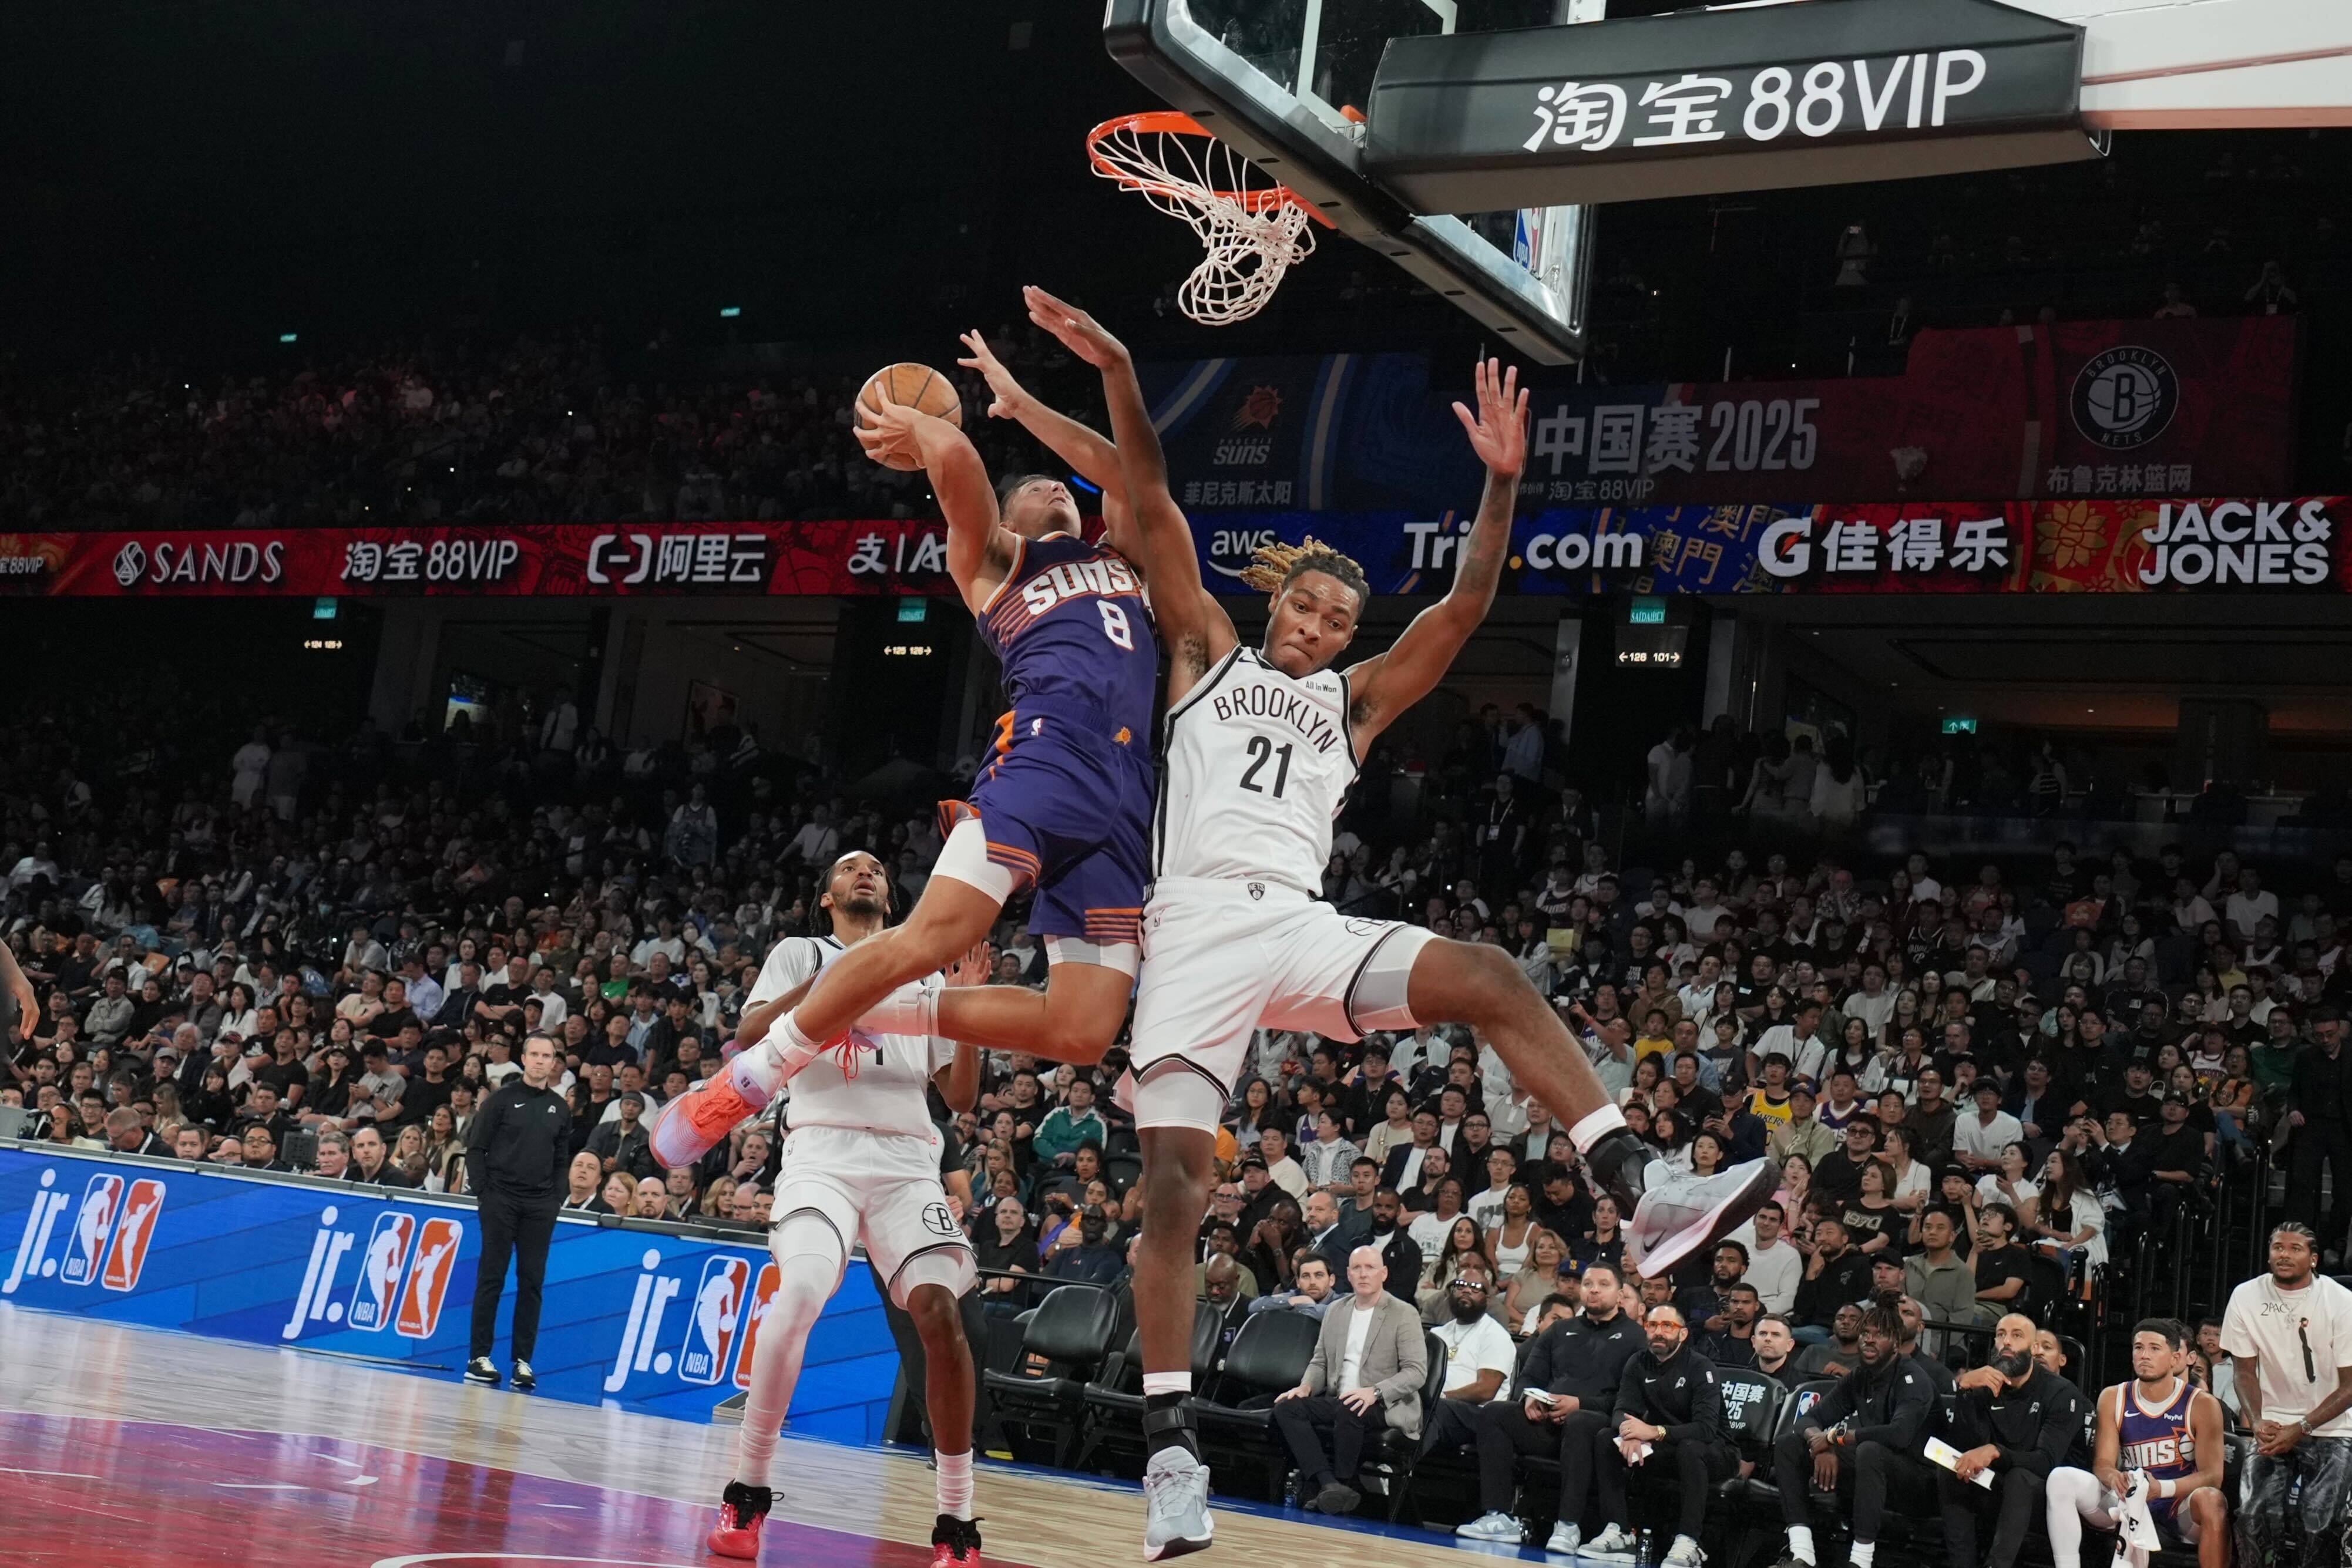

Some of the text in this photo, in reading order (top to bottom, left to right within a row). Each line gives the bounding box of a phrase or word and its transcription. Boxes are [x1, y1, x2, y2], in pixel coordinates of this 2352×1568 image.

[1523, 49, 1987, 154] 淘宝88VIP
[2086, 350, 2166, 378] BROOKLYN
[2112, 373, 2136, 423] B
[1534, 398, 1820, 475] 中国赛2025
[2101, 432, 2142, 445] NETS
[1183, 480, 1292, 506] 菲尼克斯太阳
[1548, 479, 1655, 501] 淘宝88VIP
[2046, 463, 2192, 493] 布鲁克林篮网
[2141, 500, 2332, 543] JACK&
[151, 540, 284, 584] SANDS
[340, 540, 519, 582] 淘宝88VIP
[654, 533, 766, 582] 阿里云
[847, 532, 888, 574] 支
[1211, 530, 1276, 556] aws
[1404, 521, 1643, 570] Tri.com
[1821, 518, 2009, 572] 佳得乐
[2139, 543, 2329, 585] JONES
[1023, 558, 1133, 615] SUNS
[1096, 599, 1134, 650] 8
[1653, 652, 1670, 662] 101
[1305, 681, 1314, 690] All
[1322, 684, 1337, 693] Won
[1213, 685, 1338, 753] BROOKLYN
[1239, 735, 1292, 799] 21
[1, 1168, 70, 1294] jr.
[66, 1257, 86, 1277] NBA
[282, 1206, 355, 1340] jr.
[354, 1301, 376, 1323] NBA
[603, 1249, 681, 1392] jr.
[685, 1352, 709, 1375] NBA
[1721, 1381, 1767, 1404] 中国赛
[1729, 1421, 1746, 1430] 8VIP
[2163, 1413, 2183, 1421] PayPal
